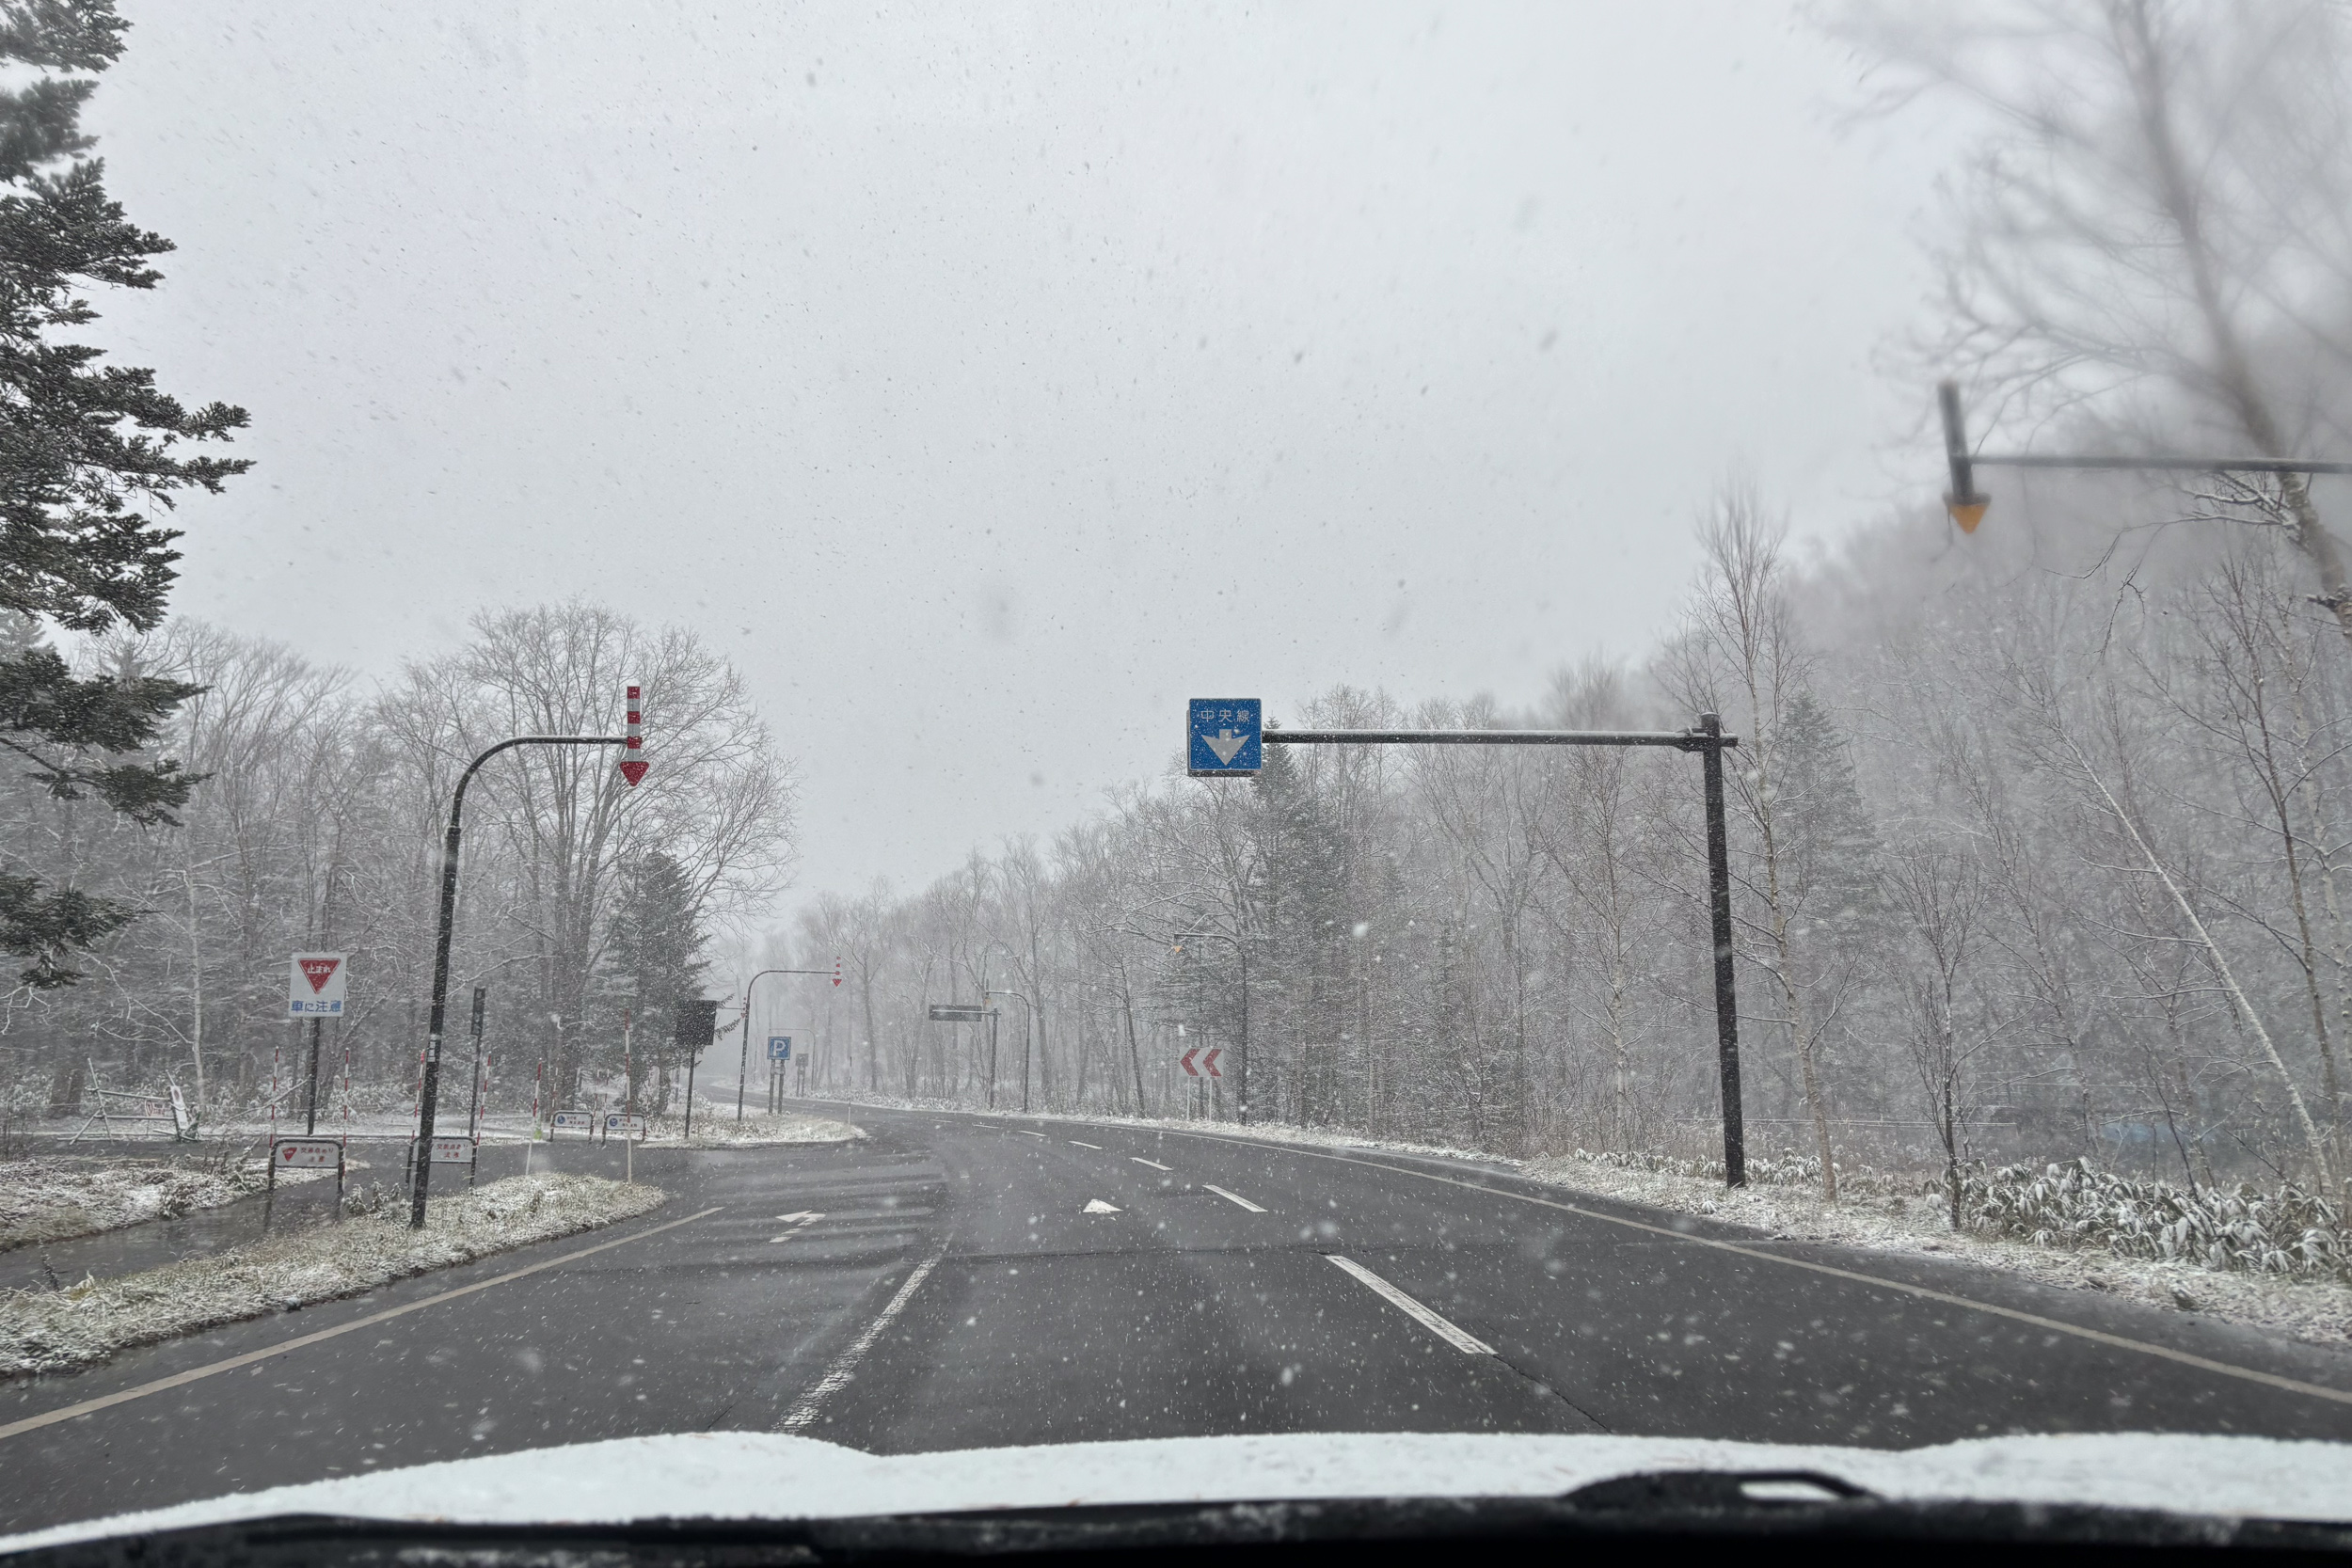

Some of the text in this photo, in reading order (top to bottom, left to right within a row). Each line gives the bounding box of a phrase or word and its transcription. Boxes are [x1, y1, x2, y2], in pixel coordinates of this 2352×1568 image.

[1200, 708, 1250, 722] 中央線
[307, 963, 332, 974] 止まれ
[291, 1000, 342, 1013] 車に注意
[772, 1039, 786, 1057] P
